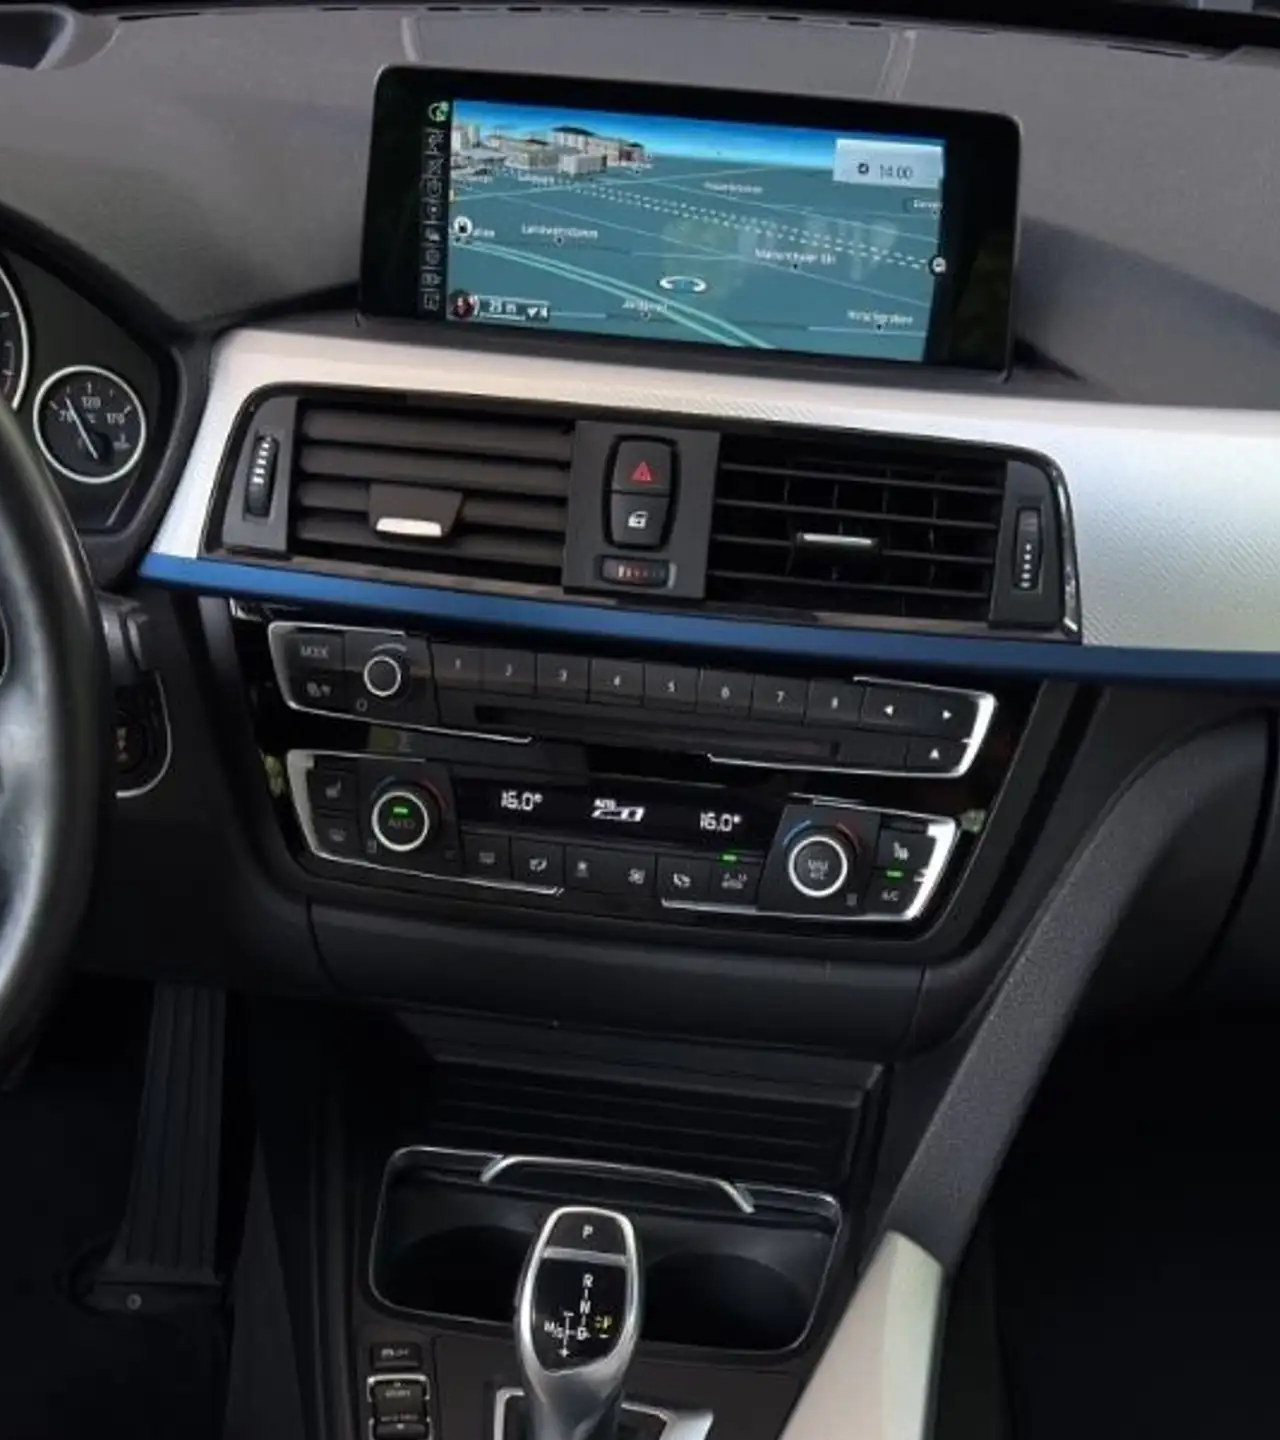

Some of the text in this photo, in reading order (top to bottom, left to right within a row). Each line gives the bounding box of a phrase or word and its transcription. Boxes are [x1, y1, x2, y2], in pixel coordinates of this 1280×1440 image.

[582, 1223, 594, 1239] P
[582, 1273, 594, 1288] R
[579, 1299, 591, 1314] N
